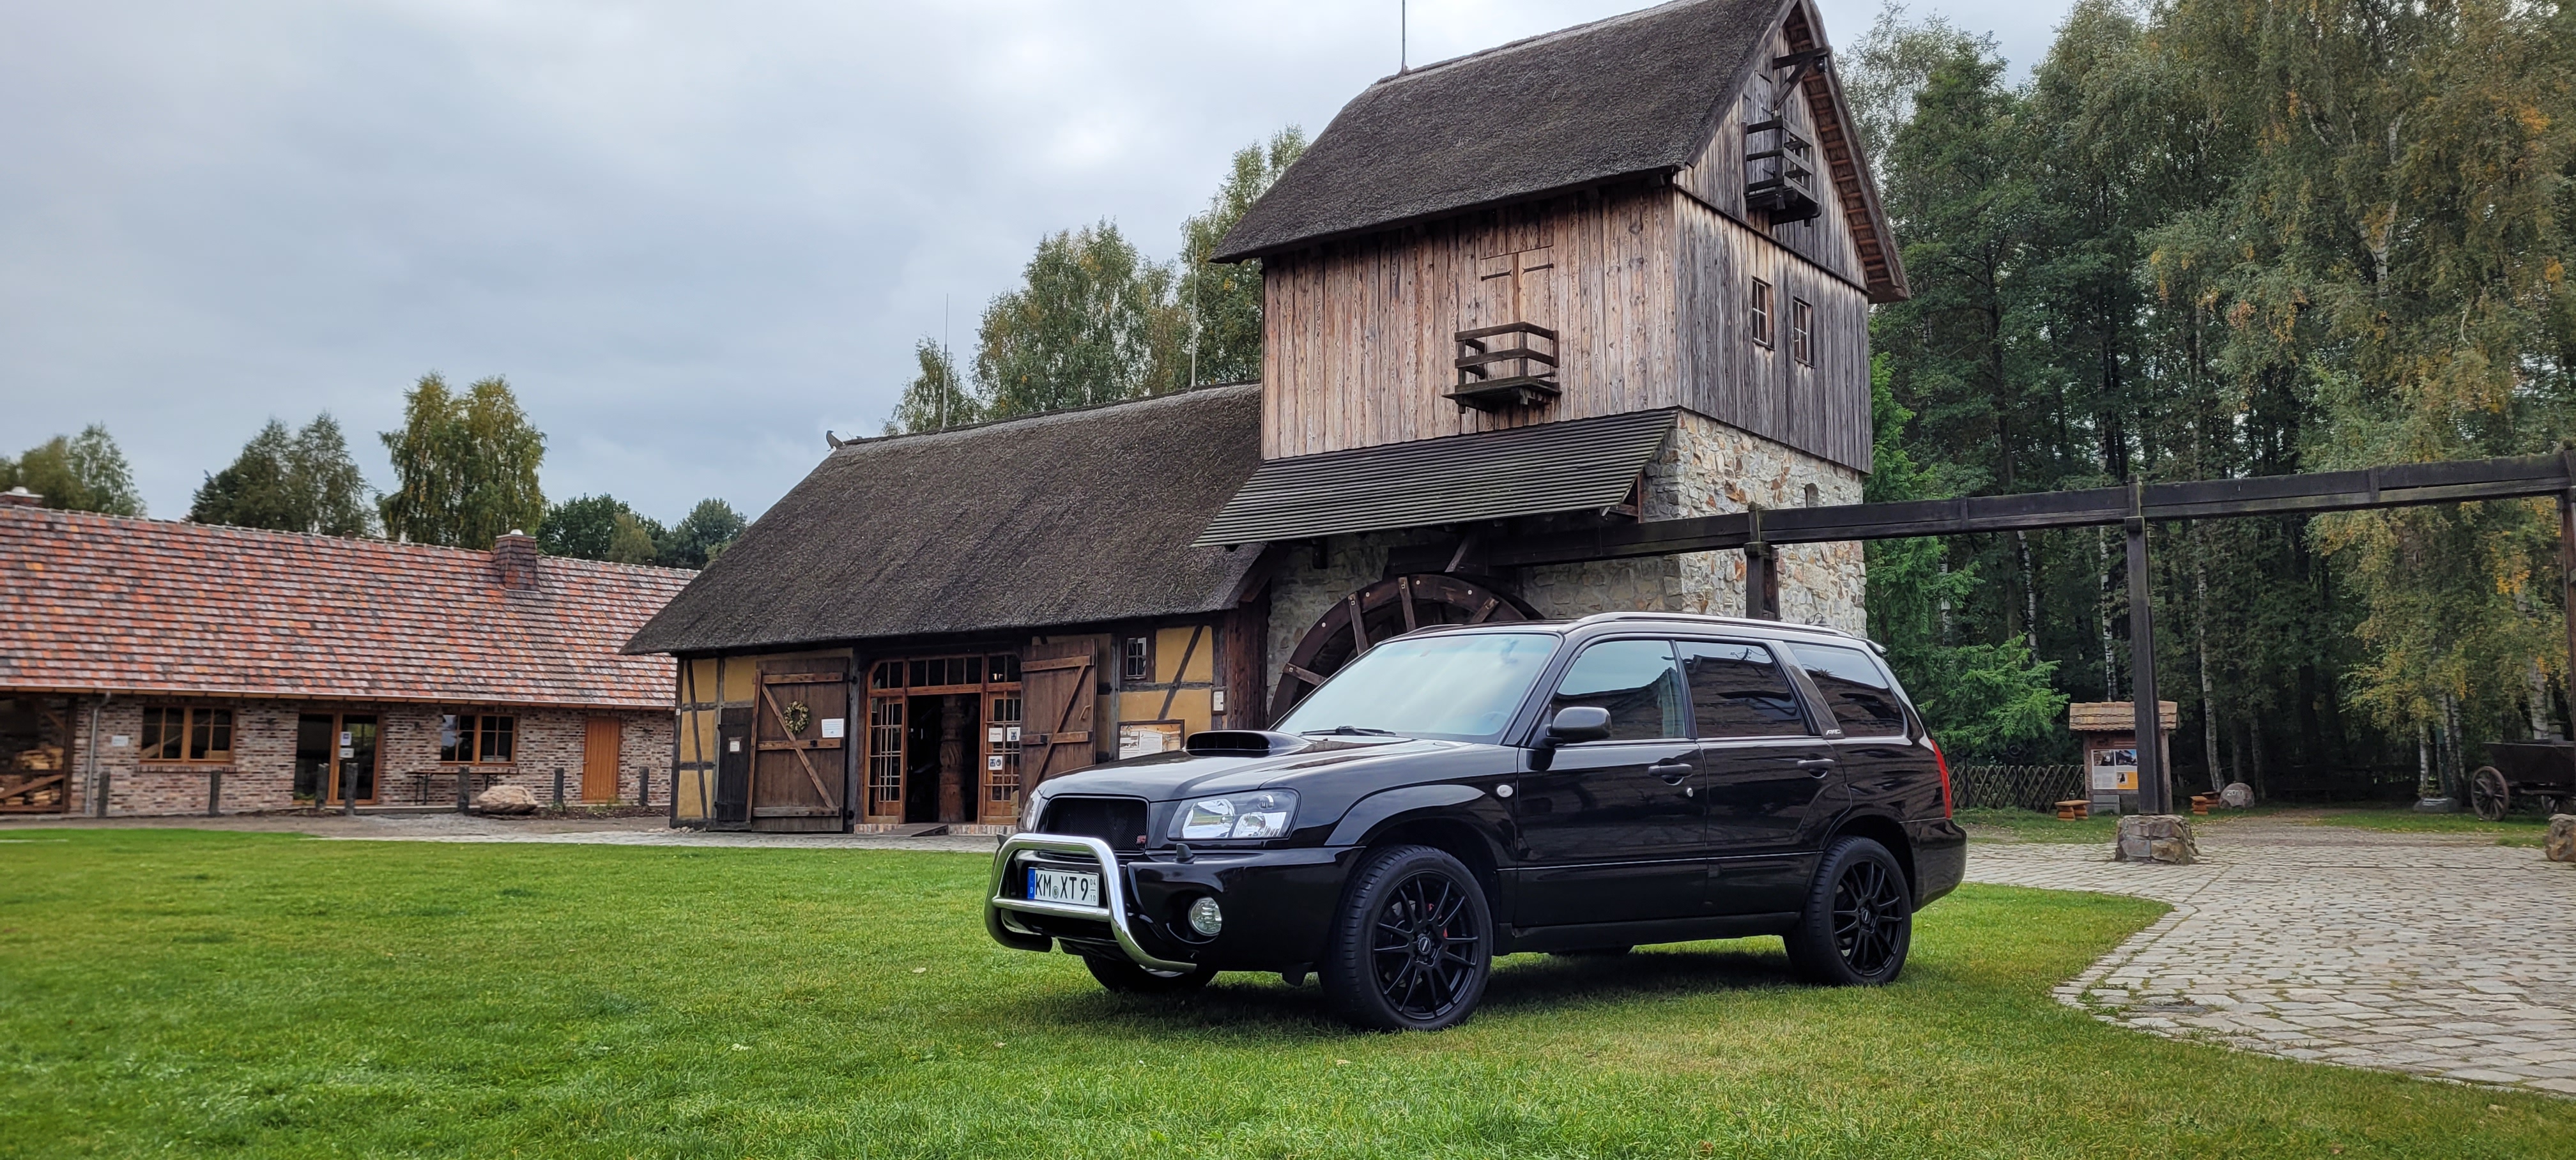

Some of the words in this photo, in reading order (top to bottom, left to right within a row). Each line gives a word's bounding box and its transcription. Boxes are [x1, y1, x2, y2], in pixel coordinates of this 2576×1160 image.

[1035, 873, 1052, 897] KM
[1061, 876, 1077, 900] XT
[1080, 878, 1089, 901] 9
